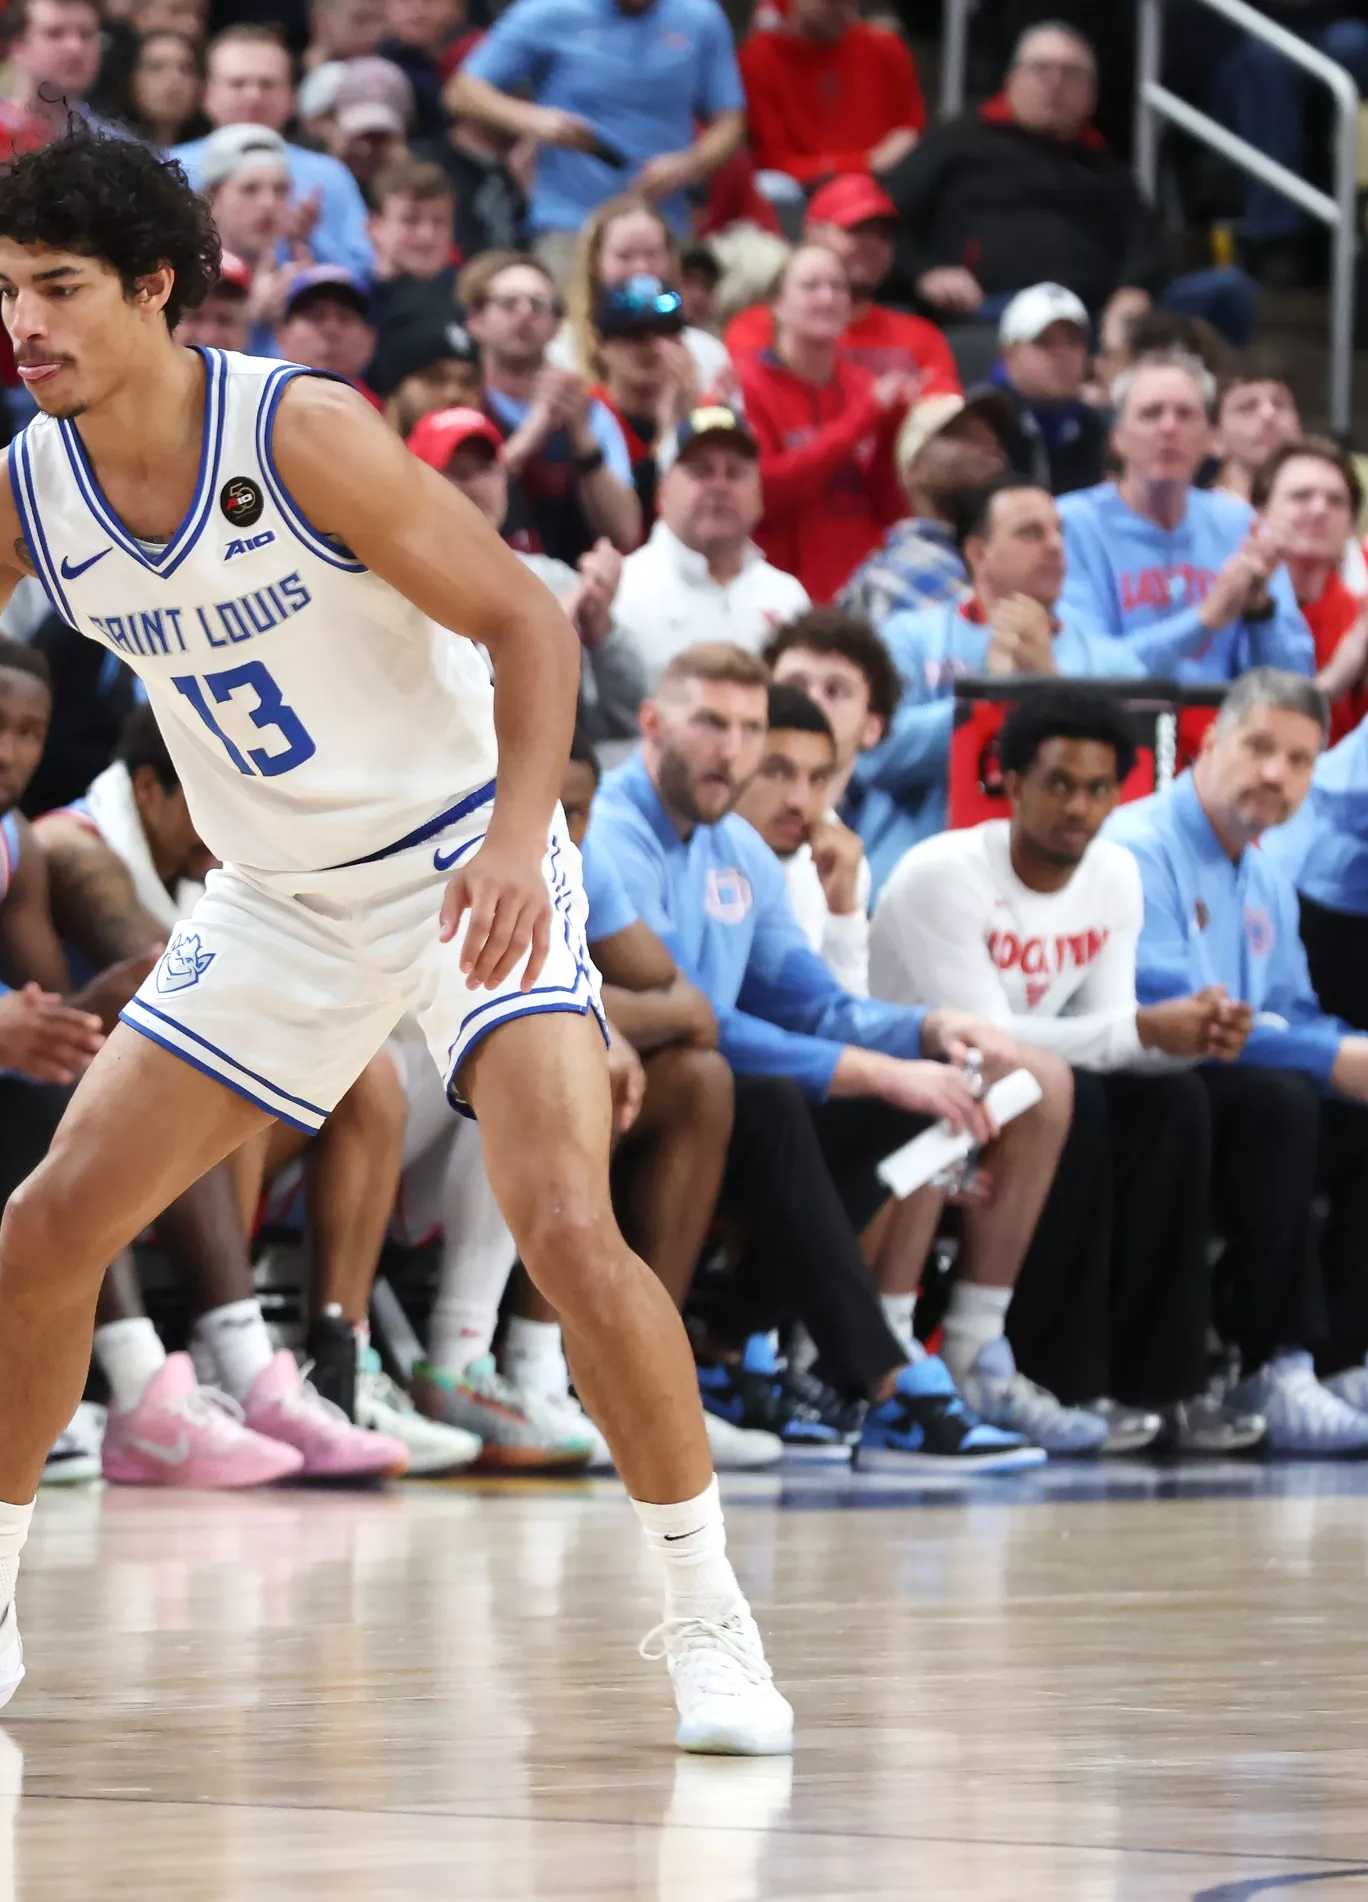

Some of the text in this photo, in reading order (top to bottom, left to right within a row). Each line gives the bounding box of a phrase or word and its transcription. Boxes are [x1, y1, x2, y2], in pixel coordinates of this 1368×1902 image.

[223, 530, 276, 561] A10
[194, 569, 313, 649] LOUIS
[169, 660, 317, 777] 13
